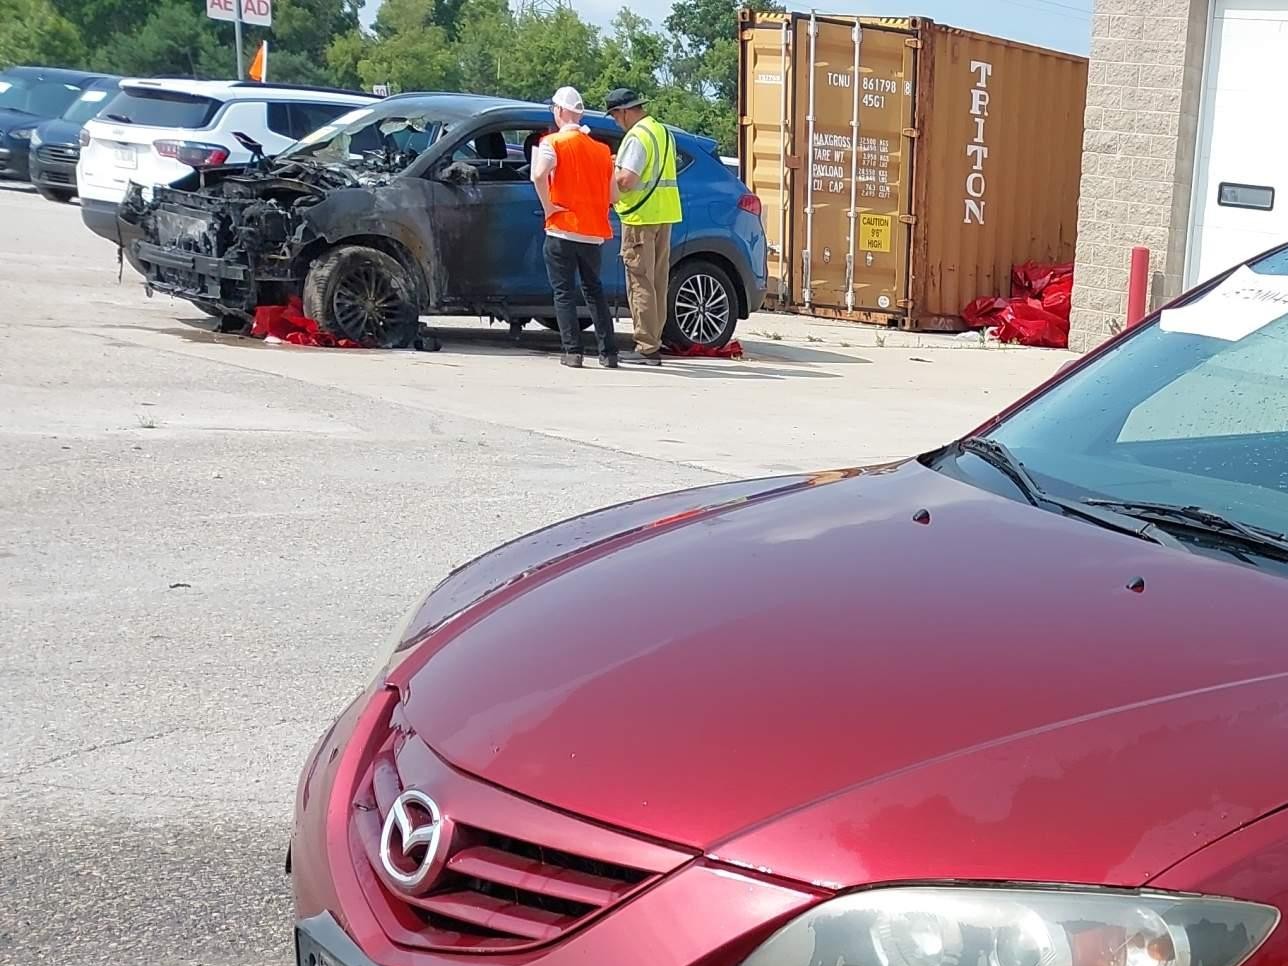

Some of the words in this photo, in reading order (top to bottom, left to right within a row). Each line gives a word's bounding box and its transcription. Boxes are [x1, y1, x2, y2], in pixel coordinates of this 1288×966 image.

[827, 72, 850, 88] TCNU
[862, 77, 896, 94] 861798
[862, 93, 885, 109] 45G1
[963, 60, 992, 225] TRITON
[814, 148, 831, 161] TARE
[812, 164, 844, 179] PAYLOAD
[862, 216, 889, 227] CAUTION
[867, 239, 882, 249] HIGH
